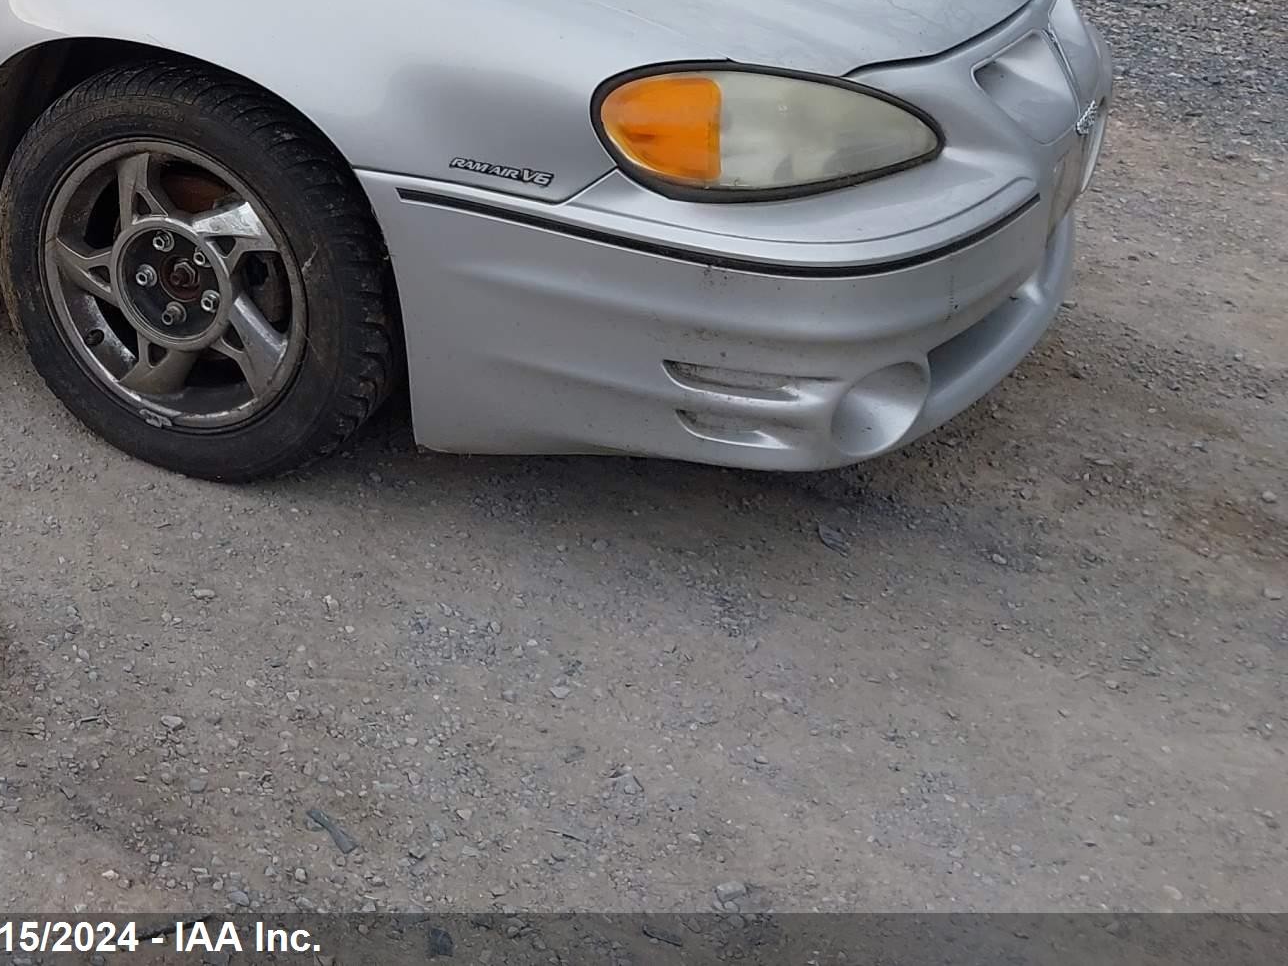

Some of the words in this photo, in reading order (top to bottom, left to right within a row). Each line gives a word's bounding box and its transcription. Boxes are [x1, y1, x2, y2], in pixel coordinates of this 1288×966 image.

[451, 158, 489, 172] RAM
[488, 166, 520, 179] AIR
[521, 169, 553, 185] V6
